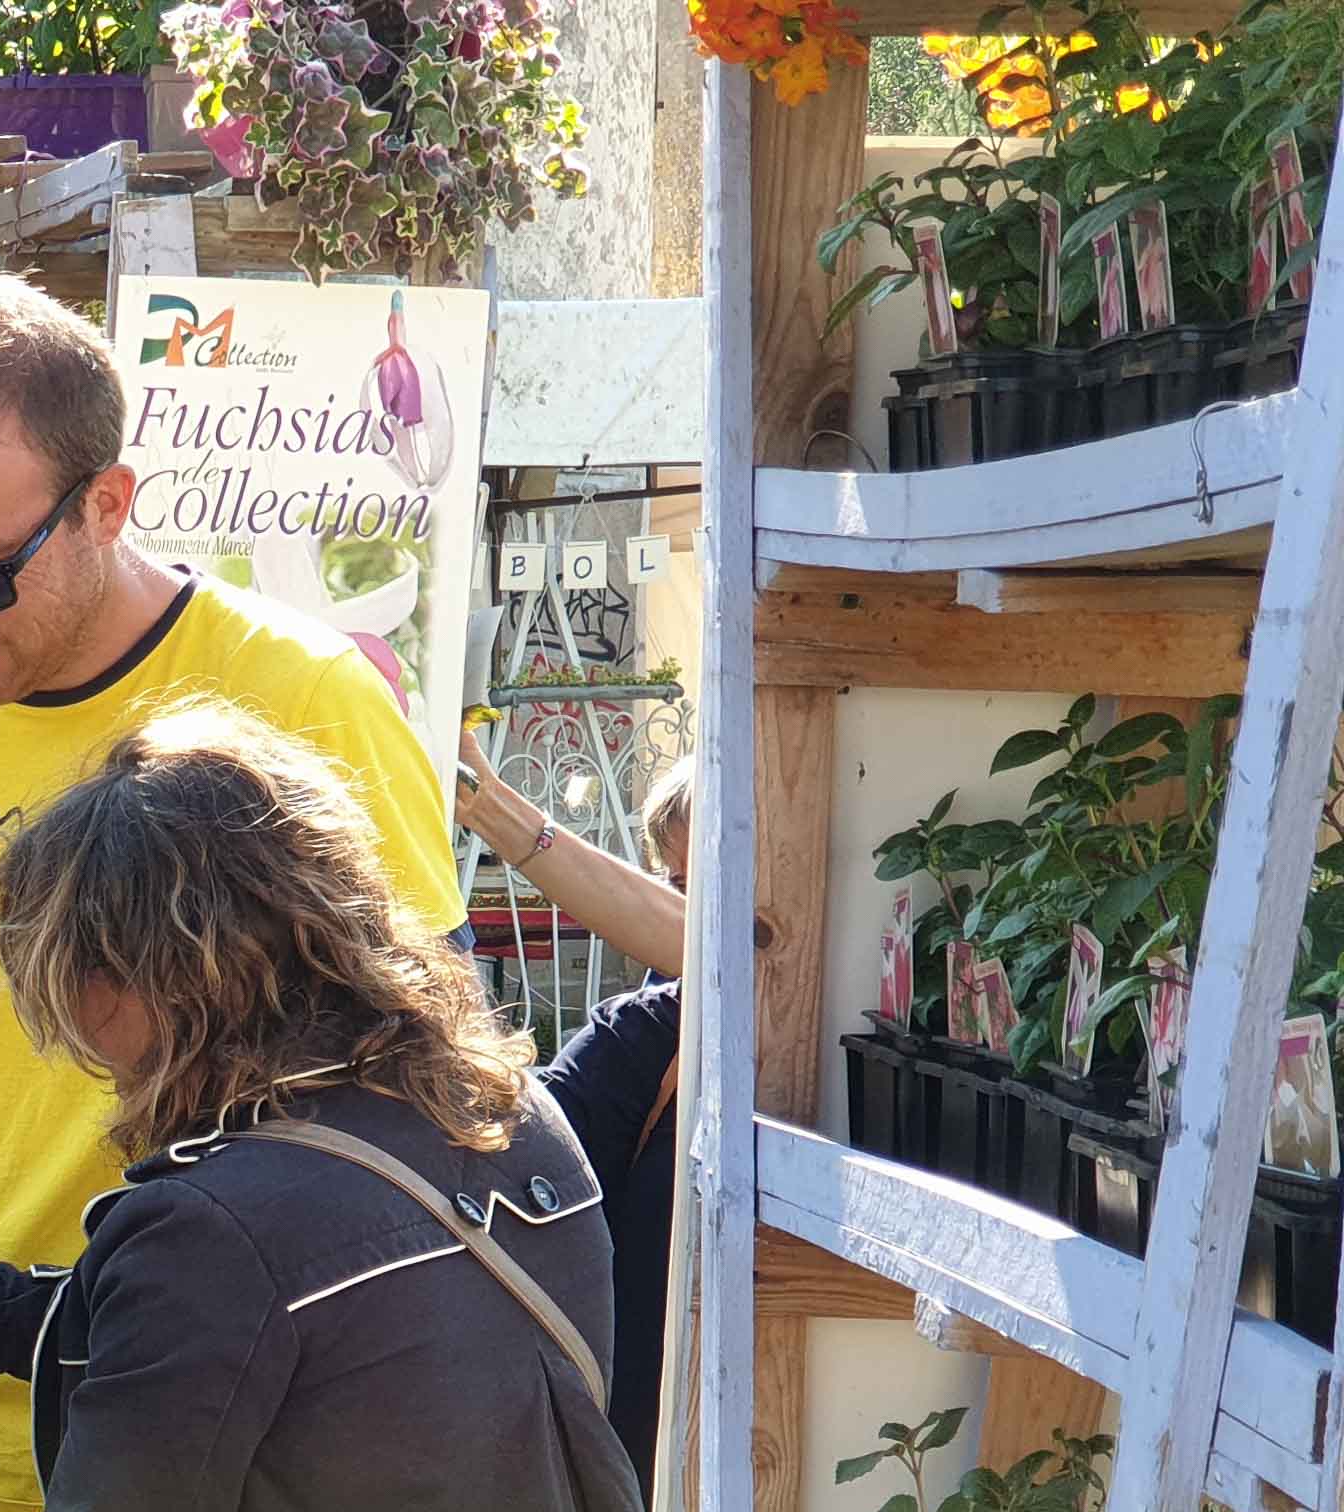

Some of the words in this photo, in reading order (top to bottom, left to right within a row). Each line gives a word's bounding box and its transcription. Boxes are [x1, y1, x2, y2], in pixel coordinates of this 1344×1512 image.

[194, 335, 298, 369] Collection
[127, 384, 397, 457] Fuchsias
[179, 448, 223, 486] de
[129, 465, 432, 542] Collection
[212, 535, 256, 557] Marcel
[510, 556, 527, 577] B
[573, 555, 593, 579] O
[639, 548, 656, 572] L
